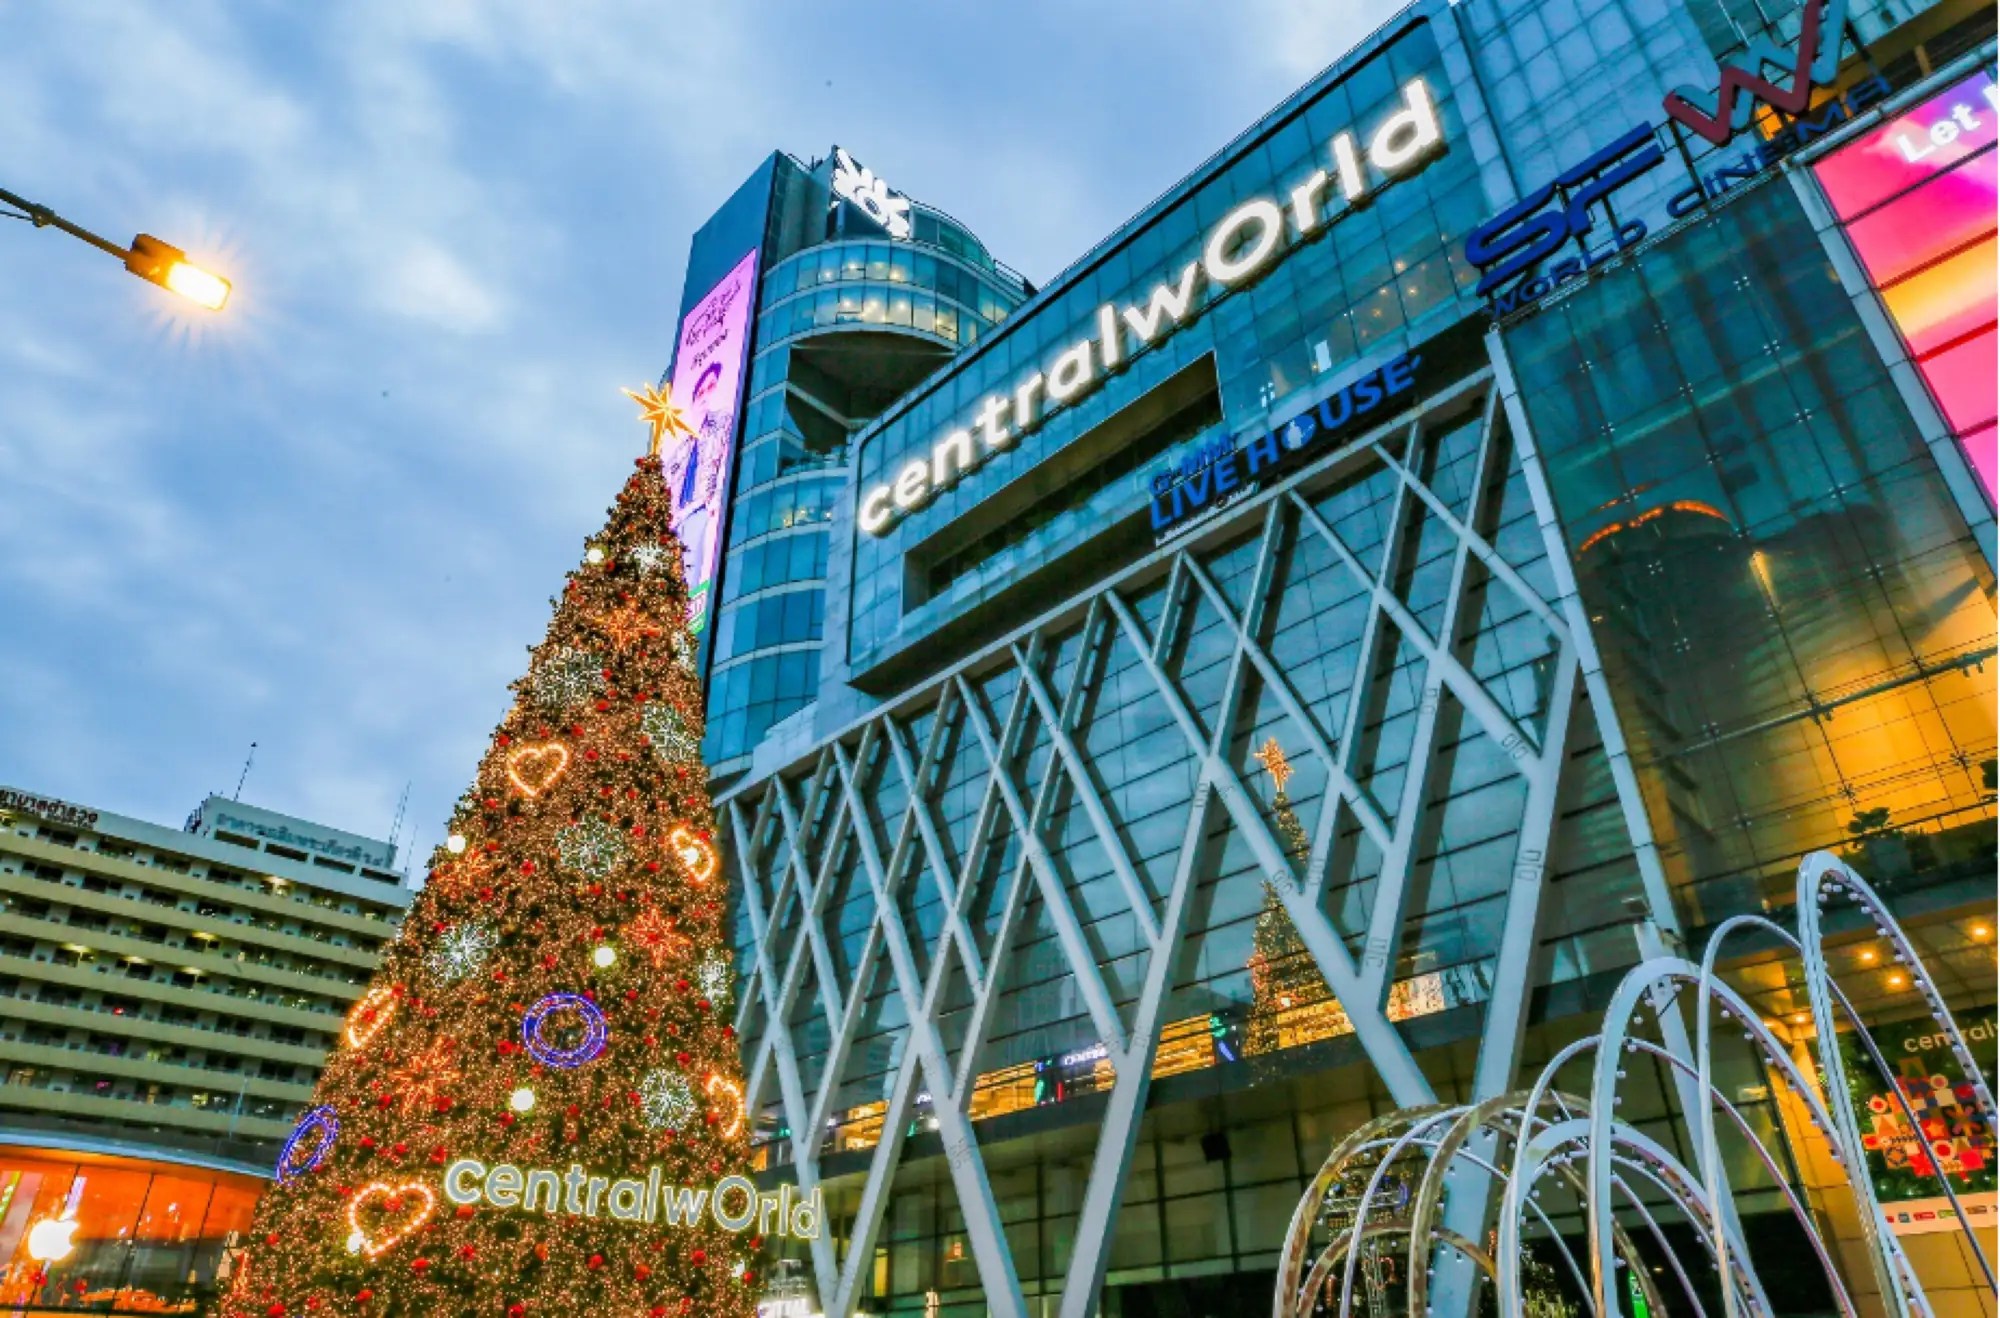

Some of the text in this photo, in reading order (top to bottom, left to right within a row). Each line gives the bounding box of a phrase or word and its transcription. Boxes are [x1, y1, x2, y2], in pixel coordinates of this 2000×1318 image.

[1487, 75, 1892, 316] WORLD CINEMA
[1896, 103, 1981, 163] Let
[1465, 120, 1662, 297] SF
[859, 79, 1443, 534] centralwOrld
[1151, 455, 1240, 530] LIVE
[446, 1160, 822, 1238] centralwOrld
